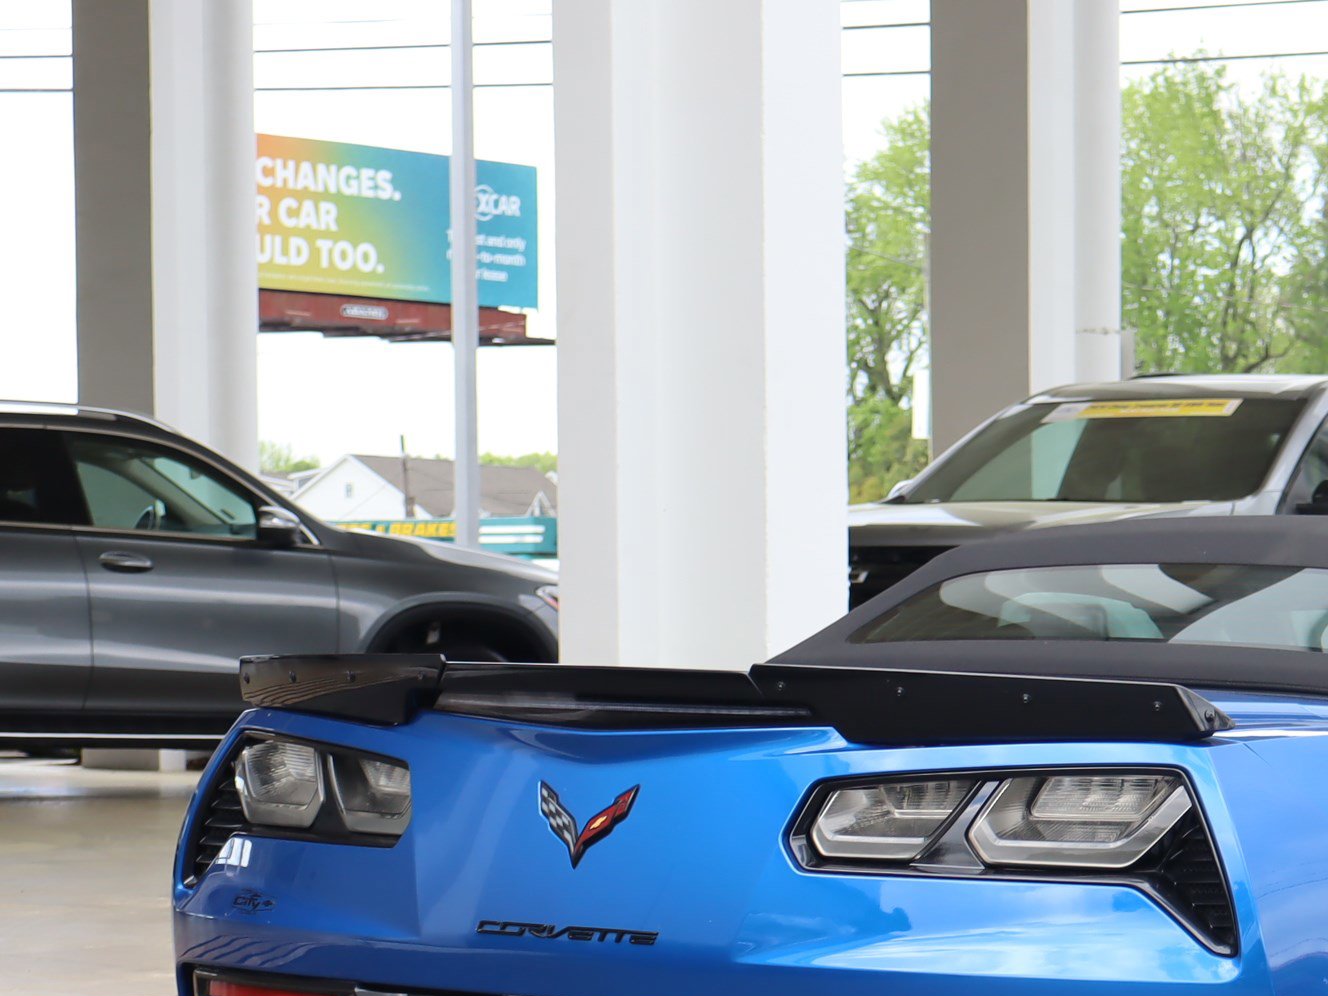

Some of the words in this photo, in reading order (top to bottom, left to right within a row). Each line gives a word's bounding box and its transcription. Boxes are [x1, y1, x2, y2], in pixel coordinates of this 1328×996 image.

[256, 156, 401, 201] CHANGES.
[278, 197, 338, 231] CAR
[316, 238, 384, 274] TOO.
[476, 920, 659, 945] CORVETTE
